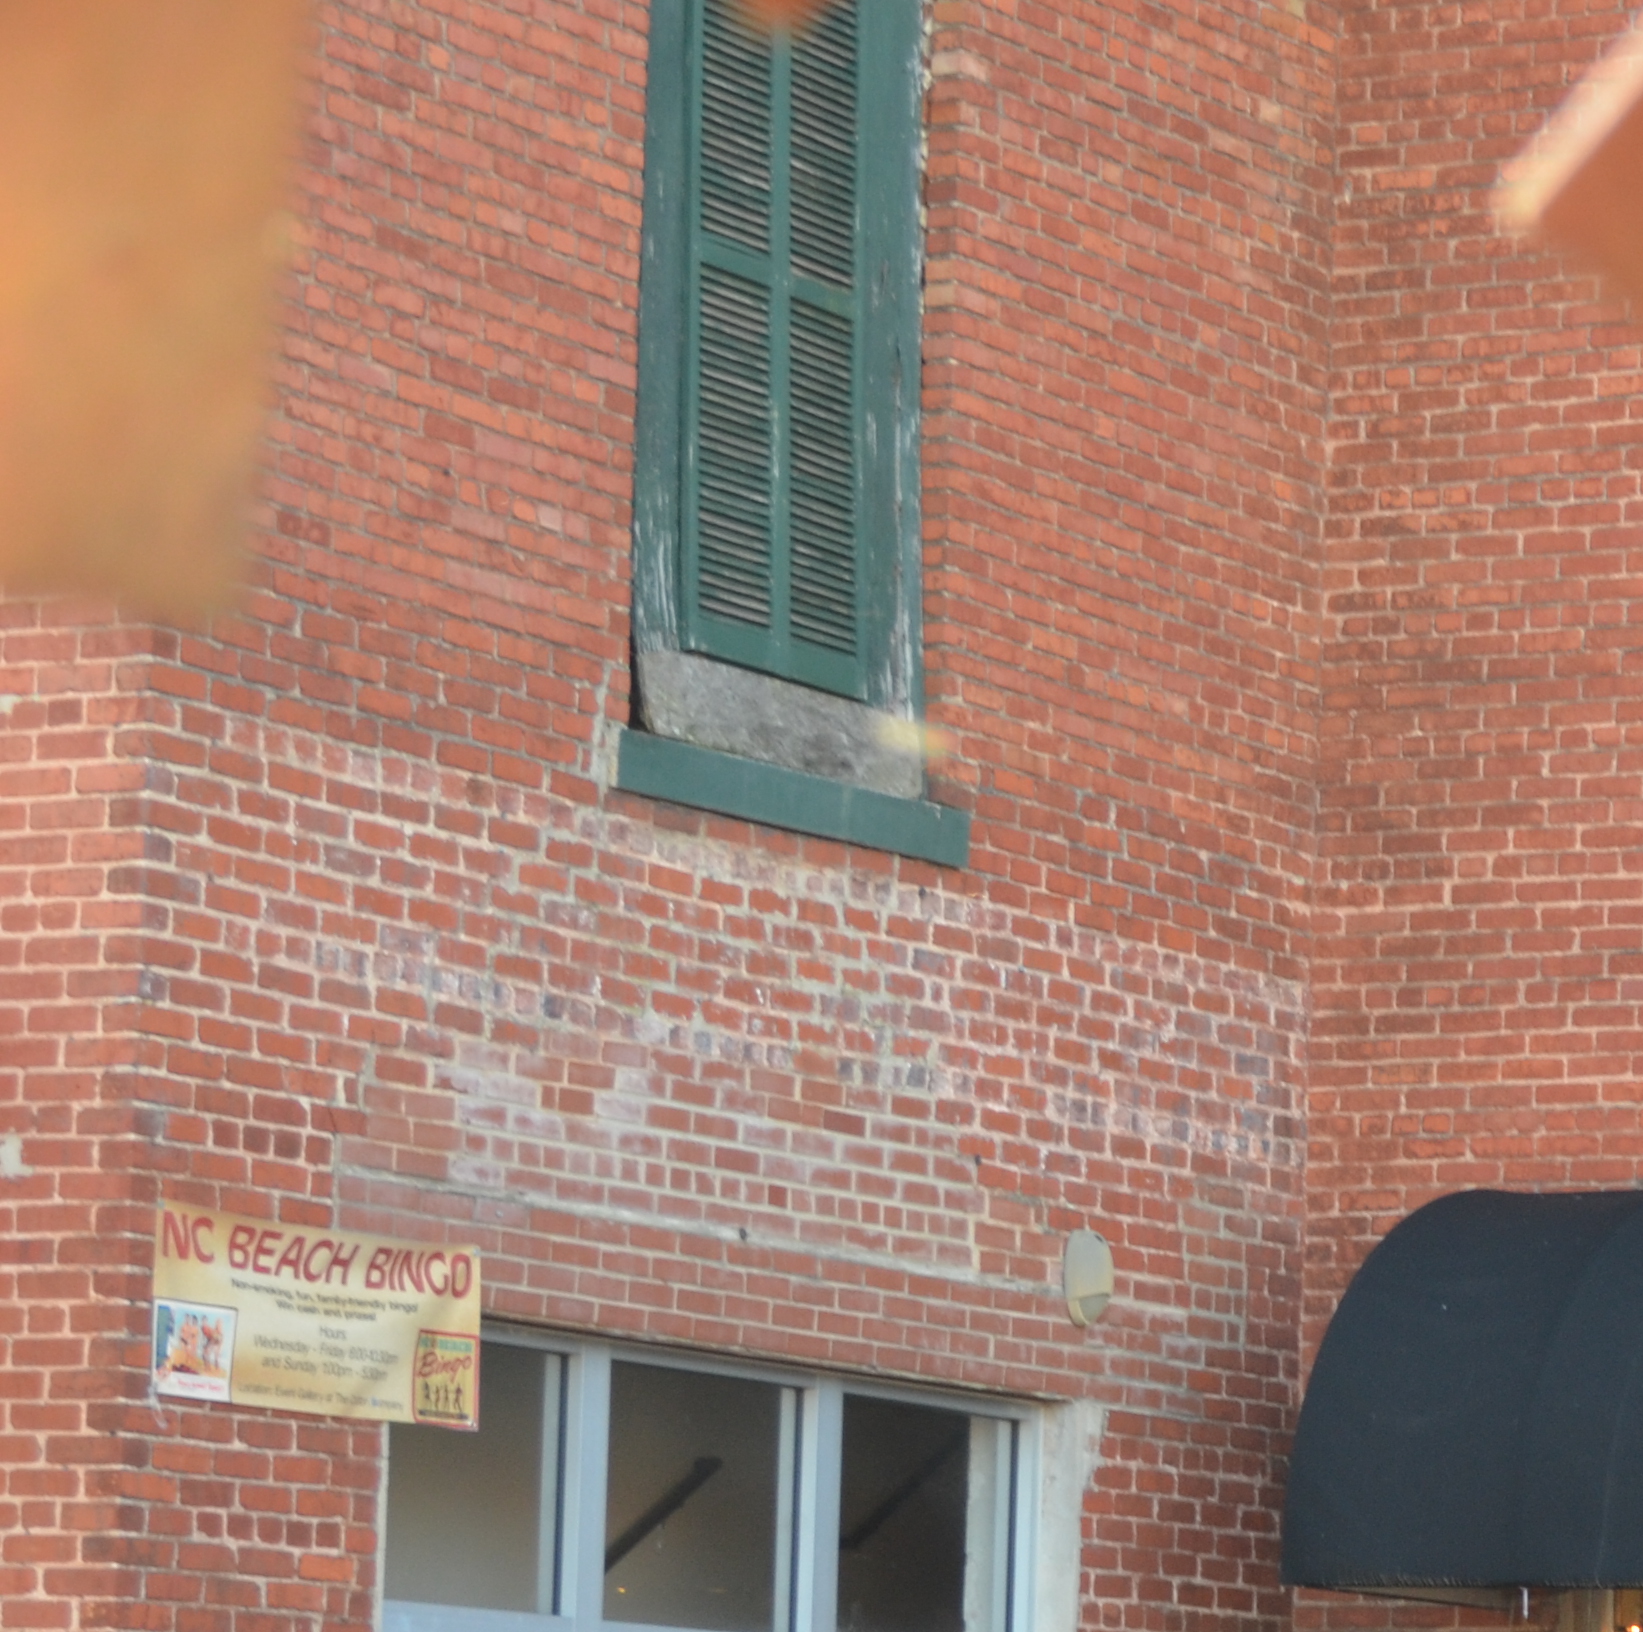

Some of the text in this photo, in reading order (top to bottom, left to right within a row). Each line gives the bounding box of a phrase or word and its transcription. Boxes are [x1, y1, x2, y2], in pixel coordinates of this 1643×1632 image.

[161, 1210, 474, 1299] NC BEACH BINGO
